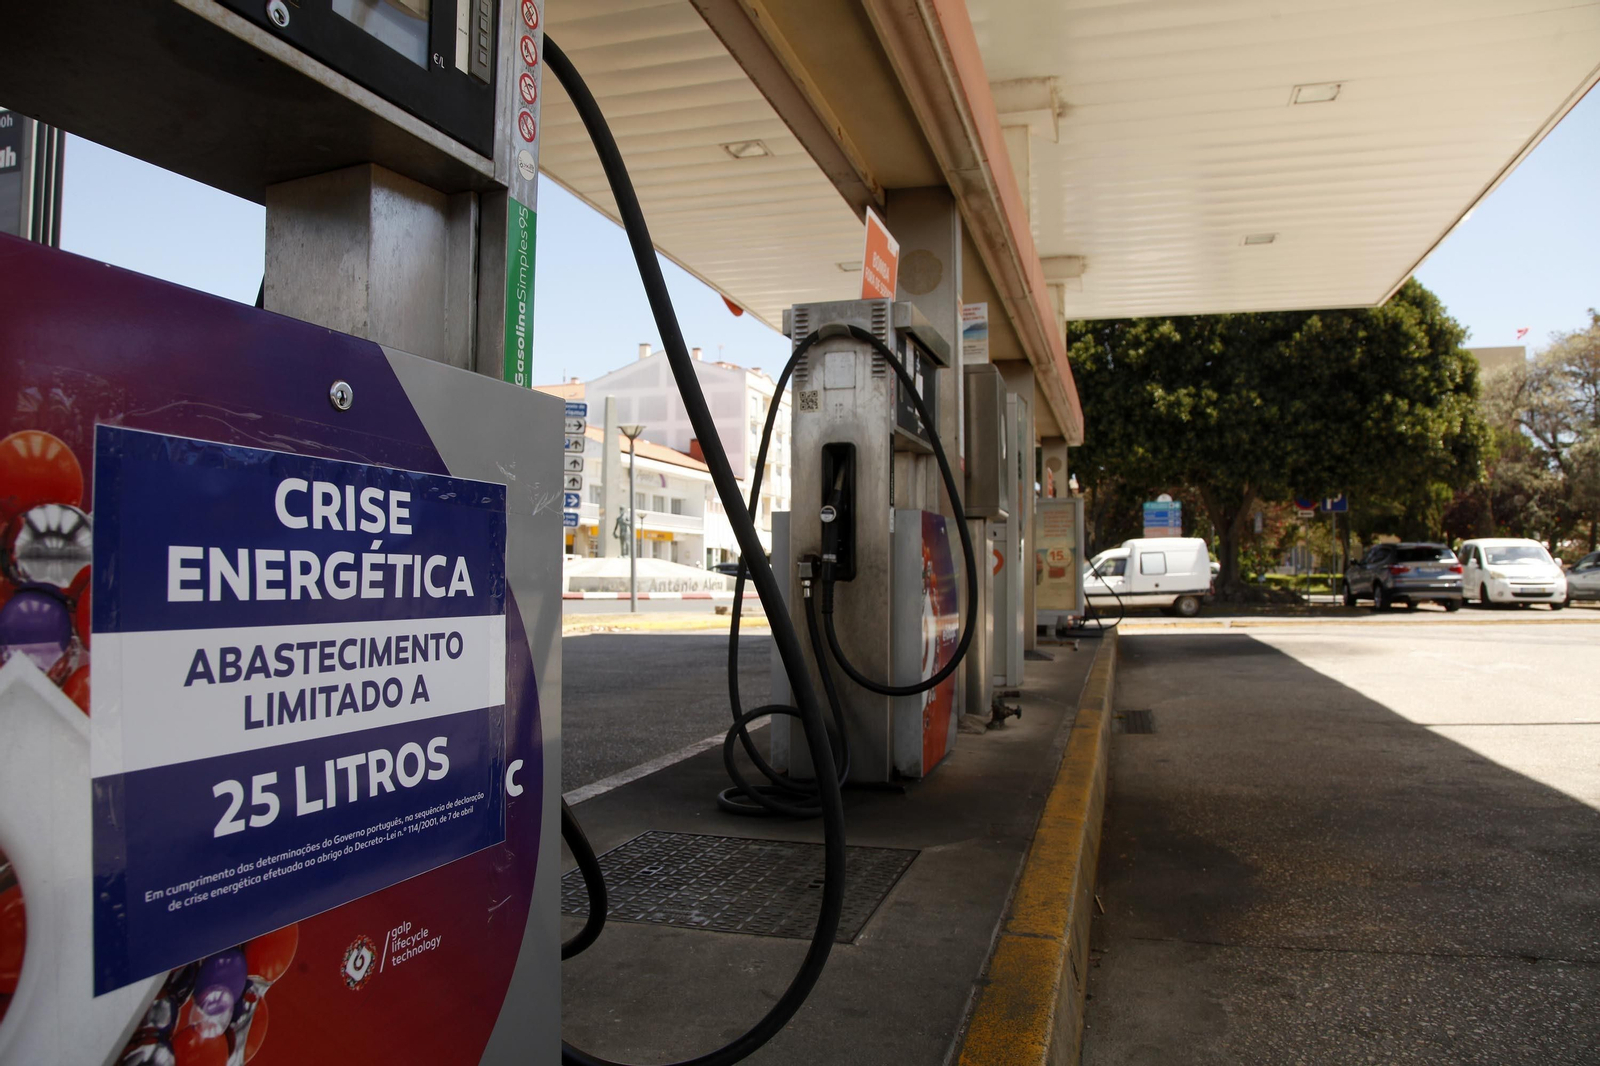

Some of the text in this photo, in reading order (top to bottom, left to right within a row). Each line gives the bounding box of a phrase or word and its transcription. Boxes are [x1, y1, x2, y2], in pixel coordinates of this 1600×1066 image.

[275, 478, 412, 535] CRISE
[167, 540, 474, 602] ENERGÉTICA
[184, 631, 463, 687] ABASTECIMENTO
[244, 674, 430, 730] LIMITADO A
[213, 737, 449, 838] 25 LITROS
[144, 791, 484, 902] Em cumprimento das determinações do Governo português, na sequência de declaração
[168, 899, 182, 911] de
[184, 892, 209, 907] crise
[210, 875, 261, 897] energética
[263, 863, 303, 881] efetuada
[304, 858, 316, 868] ao
[317, 850, 342, 866] abrigo
[344, 844, 353, 854] do
[355, 831, 397, 851] Decreto-Lei
[408, 817, 439, 834] 114/2001,
[439, 814, 447, 824] de
[452, 810, 460, 820] de
[461, 806, 474, 817] abril
[391, 921, 412, 940] galp
[391, 927, 429, 953] lifecycle
[392, 935, 442, 967] technology
